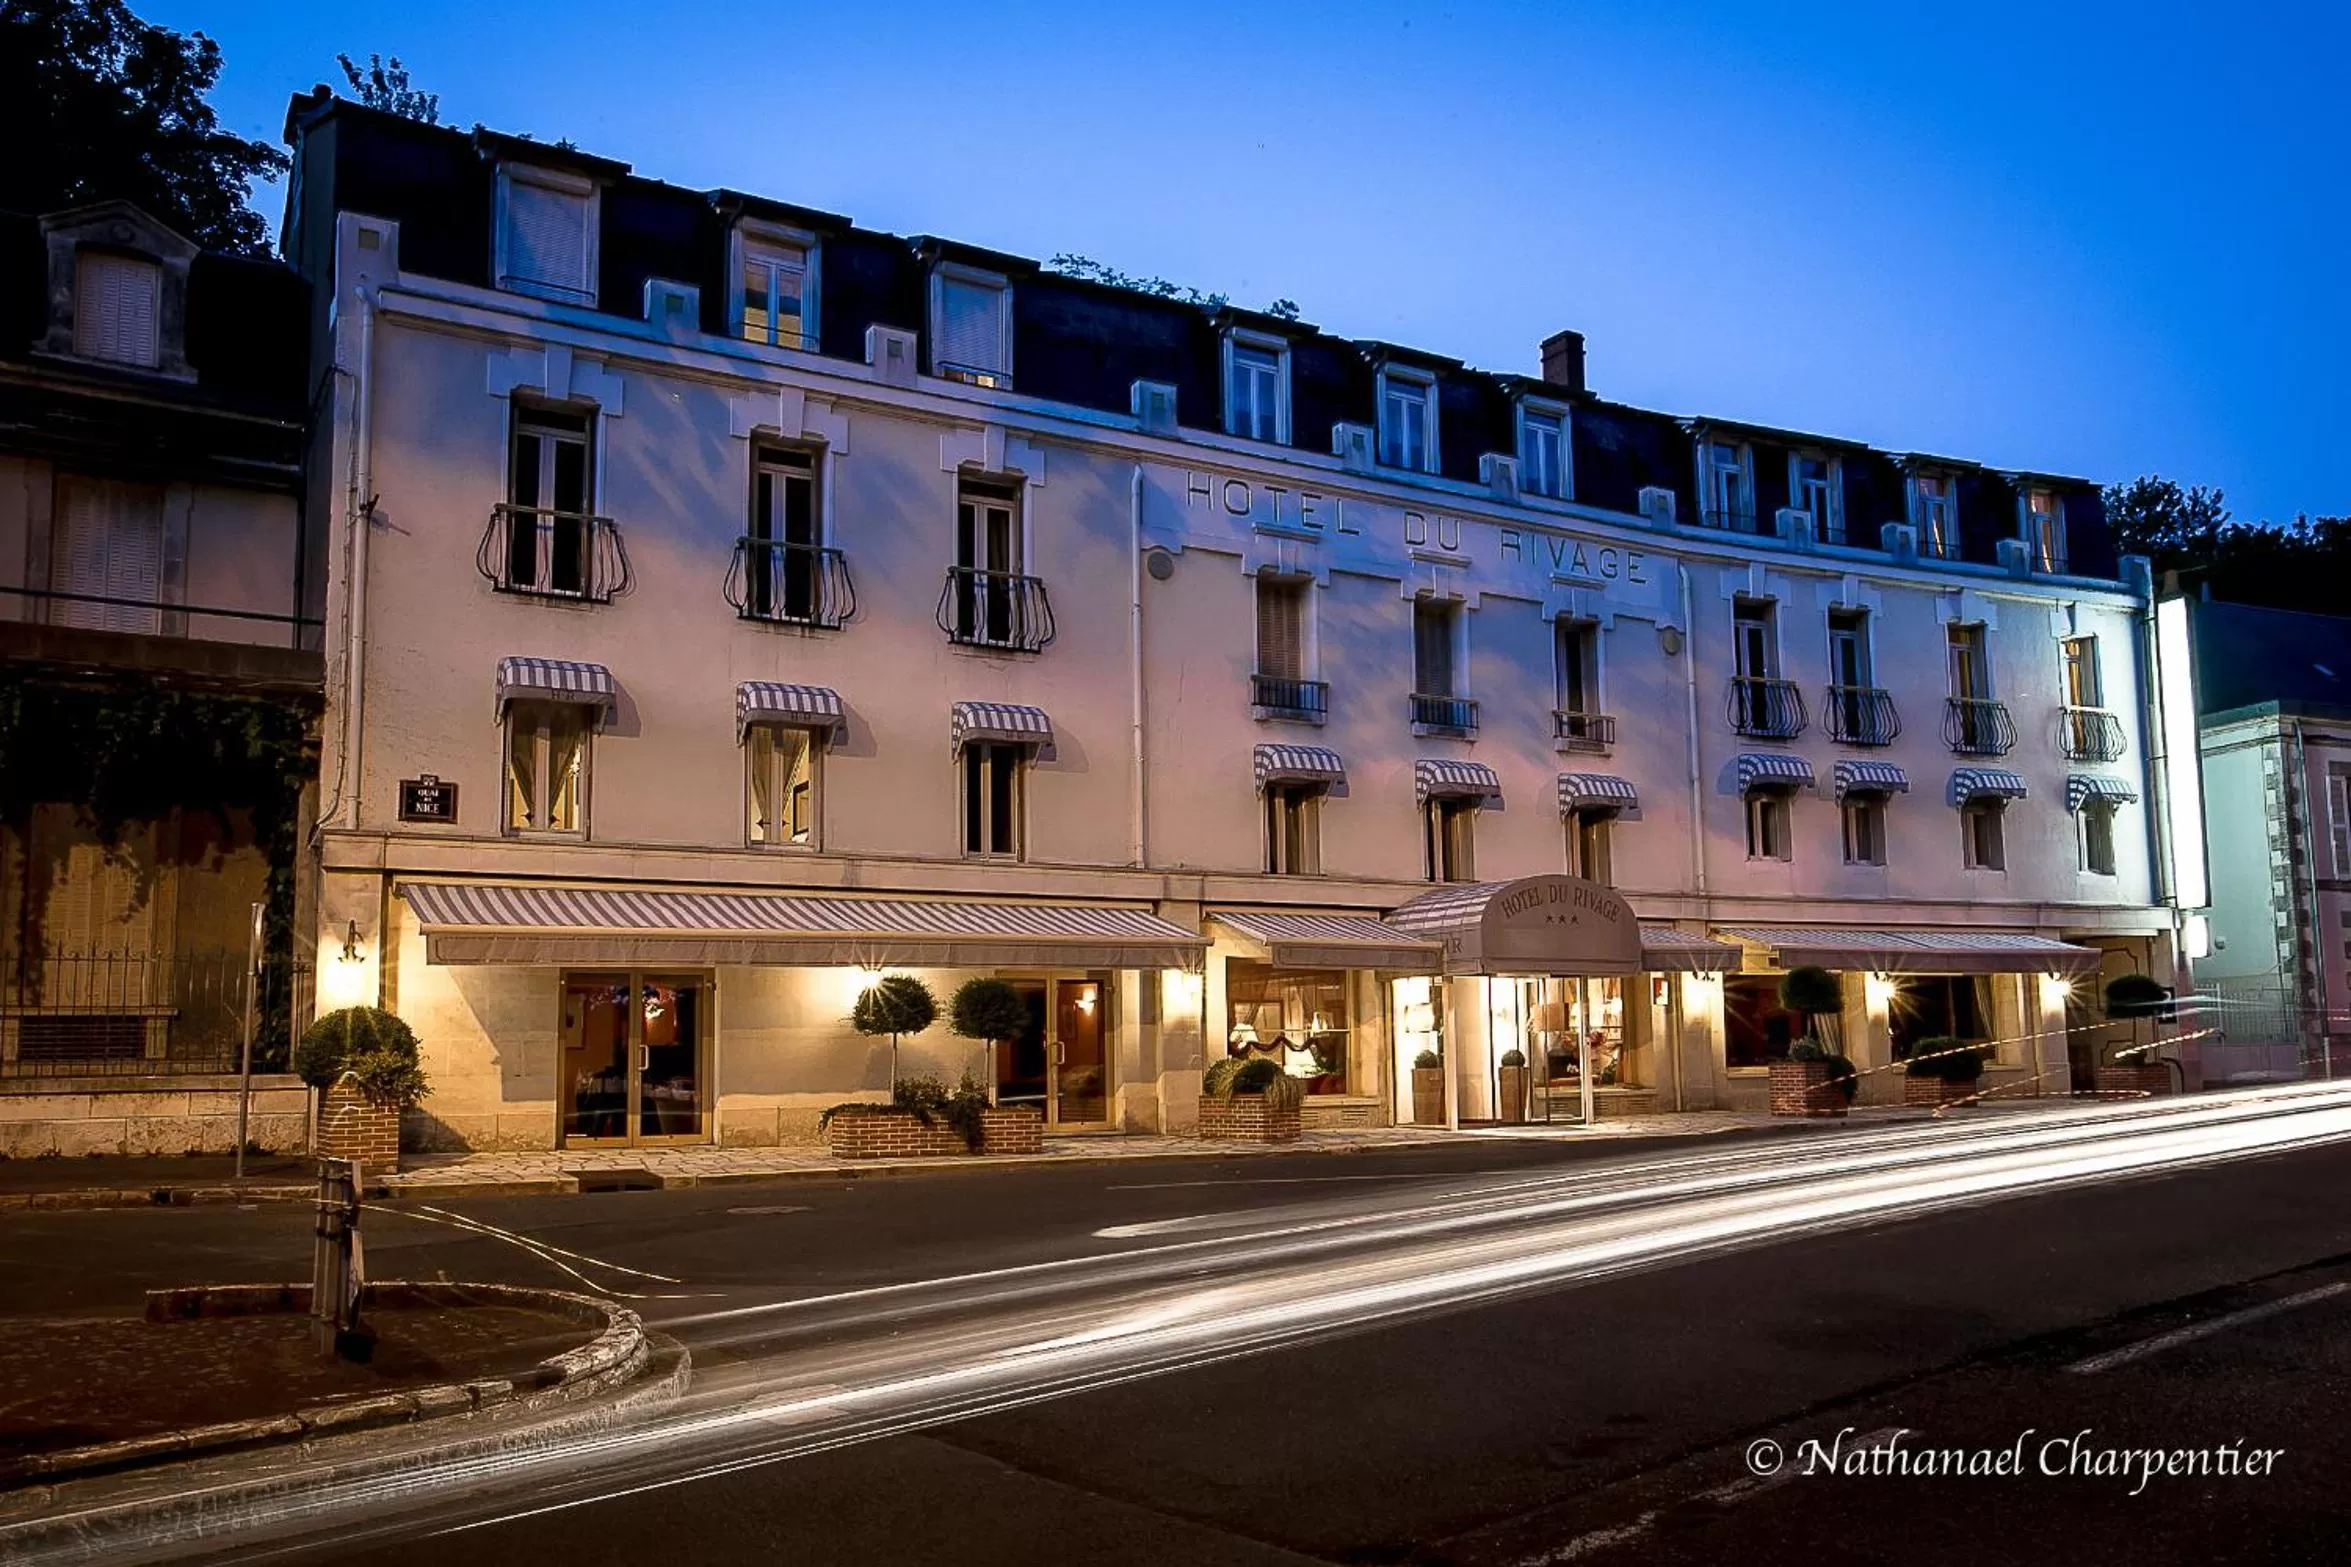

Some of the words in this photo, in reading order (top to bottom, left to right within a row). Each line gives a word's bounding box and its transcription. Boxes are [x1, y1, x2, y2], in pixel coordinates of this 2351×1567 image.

[1186, 470, 1361, 536] HOTEL
[1404, 511, 1461, 552] DU
[1501, 527, 1649, 585] RIVAGE
[415, 802, 440, 814] NICE
[1501, 886, 1543, 919] HOTEL
[1548, 884, 1568, 904] DU
[1574, 887, 1620, 923] RIVAGE
